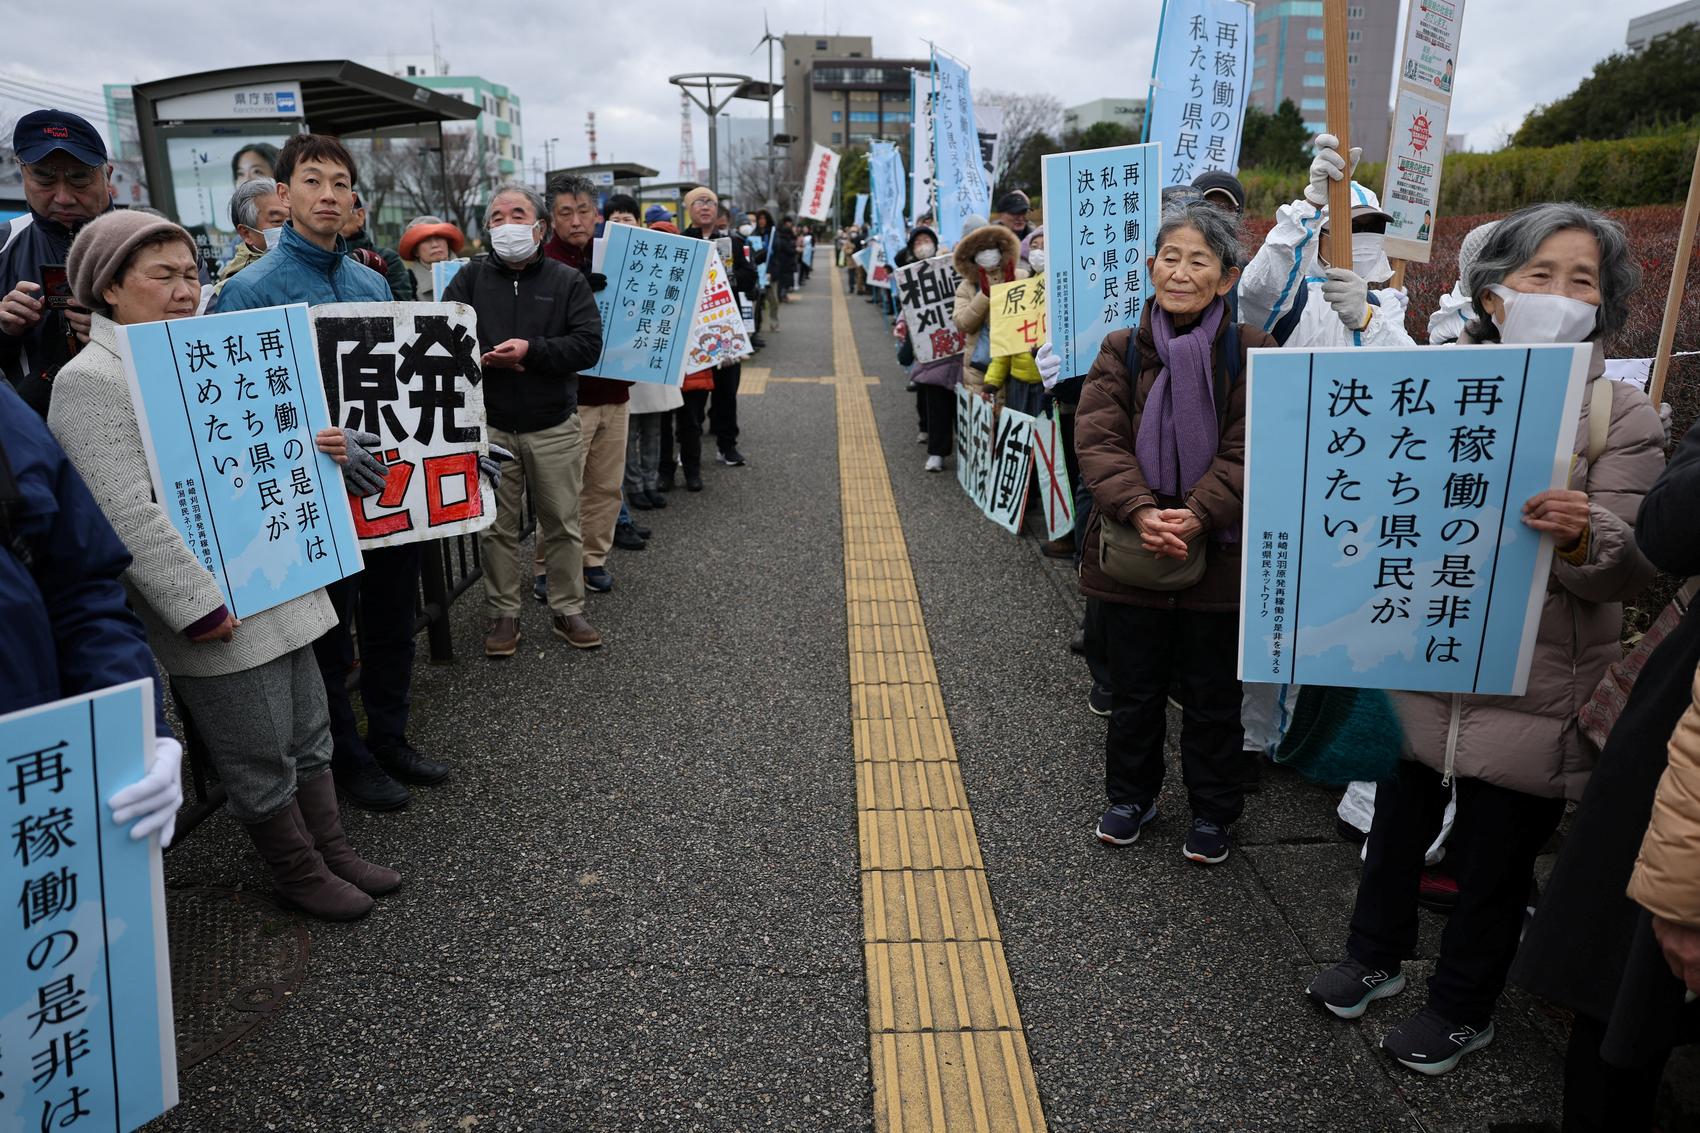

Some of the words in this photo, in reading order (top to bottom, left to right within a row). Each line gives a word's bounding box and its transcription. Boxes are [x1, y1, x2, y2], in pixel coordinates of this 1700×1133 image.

[1170, 14, 1209, 184] 私たち県民が
[621, 240, 650, 318] 決めたい。
[632, 243, 668, 350] 私たち県民が
[1077, 169, 1097, 282] 決めたい。
[1100, 166, 1119, 324] 私たち県民が
[1123, 162, 1140, 329] 再稼働の是非
[314, 315, 482, 446] 原発
[649, 247, 690, 370] 再稼働の是非は
[184, 340, 244, 490] 決めたい。
[222, 335, 290, 542] 私たち県民が
[256, 328, 328, 564] 再稼働の是非は
[1323, 378, 1374, 557] 決めたい。
[175, 480, 199, 560] 新潟県民ネットワー
[186, 478, 217, 579] 柏崎刈羽原発再稼働の是
[1260, 531, 1274, 618] 新潟県民ネットワーク
[1370, 377, 1435, 625] 私たち県民が
[1425, 375, 1505, 663] 再稼働の是非は
[1271, 531, 1289, 674] 柏崎刈羽原発再稼働の是非を考える
[7, 740, 91, 1133] 再稼働の是非は
